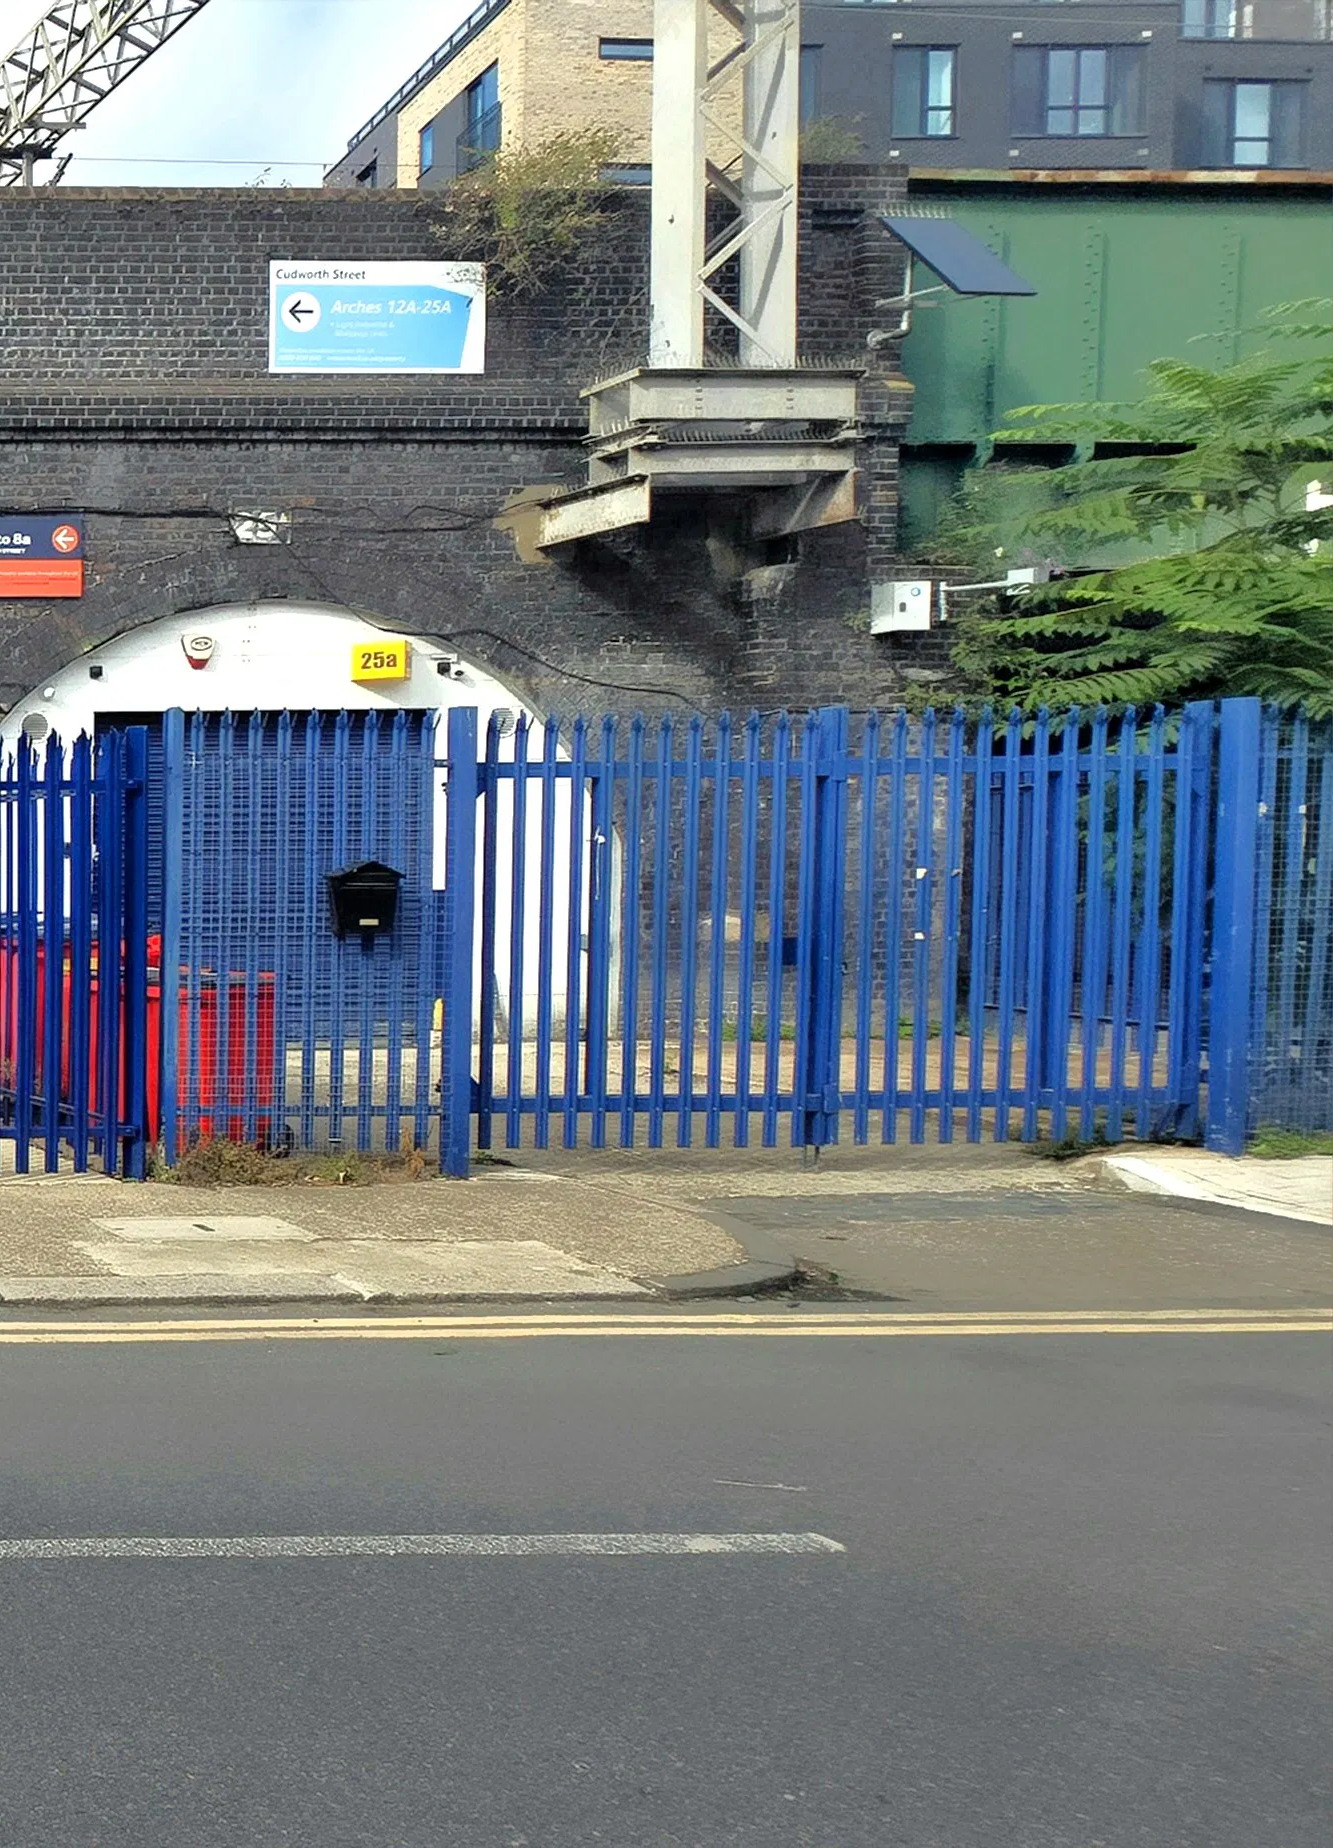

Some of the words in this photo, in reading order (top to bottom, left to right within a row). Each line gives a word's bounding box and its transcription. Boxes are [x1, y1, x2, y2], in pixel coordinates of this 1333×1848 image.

[276, 268, 330, 280] Cudworth
[333, 268, 366, 280] Street
[330, 299, 382, 314] Arches
[387, 299, 452, 315] 12A-25A
[13, 532, 31, 545] 8a
[360, 652, 398, 669] 25a
